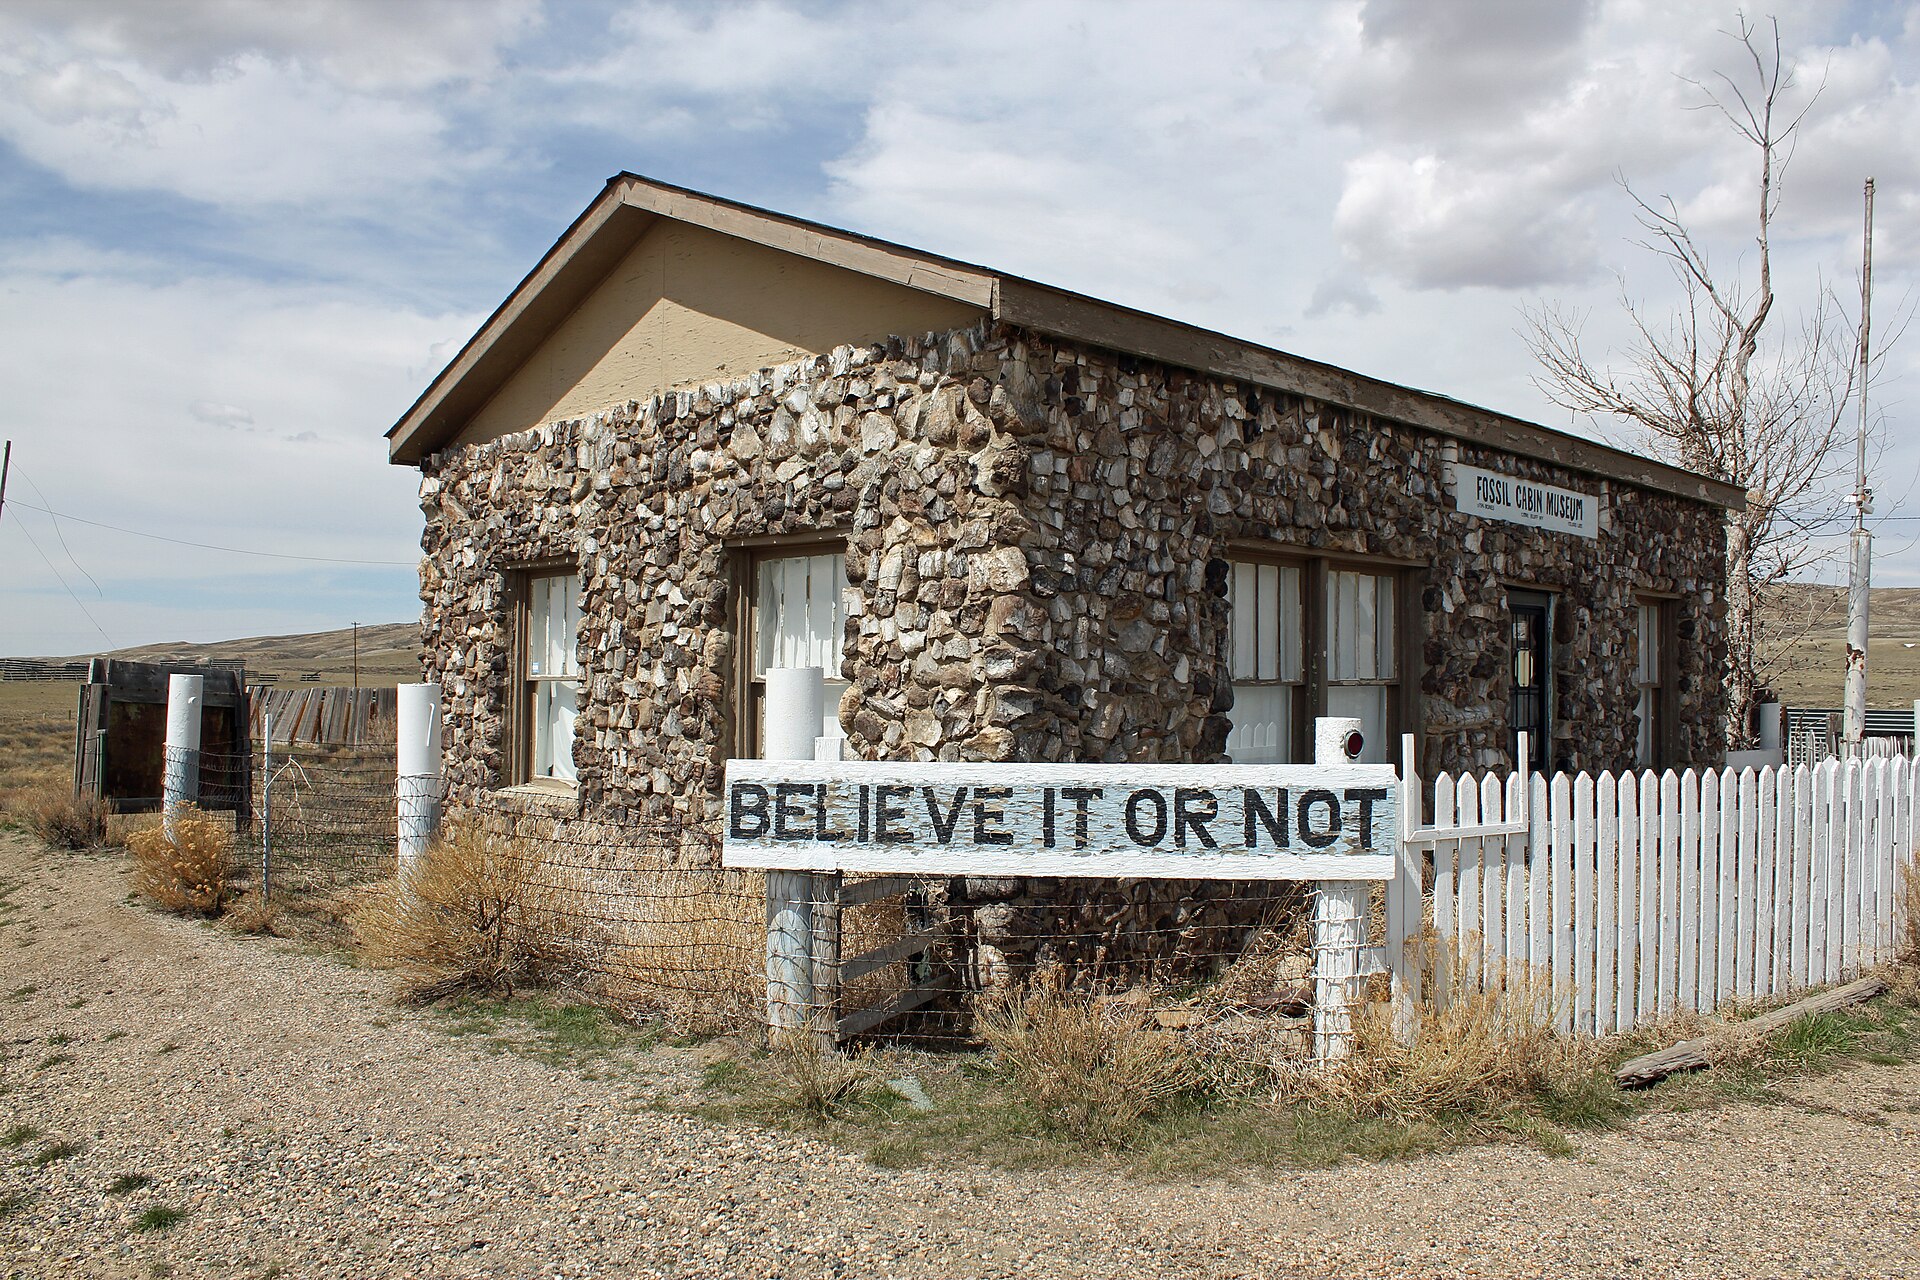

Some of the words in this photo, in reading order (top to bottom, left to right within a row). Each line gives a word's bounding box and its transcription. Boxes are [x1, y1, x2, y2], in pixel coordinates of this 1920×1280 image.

[1476, 476, 1511, 506] FOSSIL
[1515, 485, 1543, 513] CABIN
[1546, 492, 1582, 521] MUSEUM
[730, 783, 1013, 845] BELIEVE
[1043, 787, 1103, 849] IT
[1125, 788, 1218, 849] OR
[1244, 788, 1387, 851] NOT
